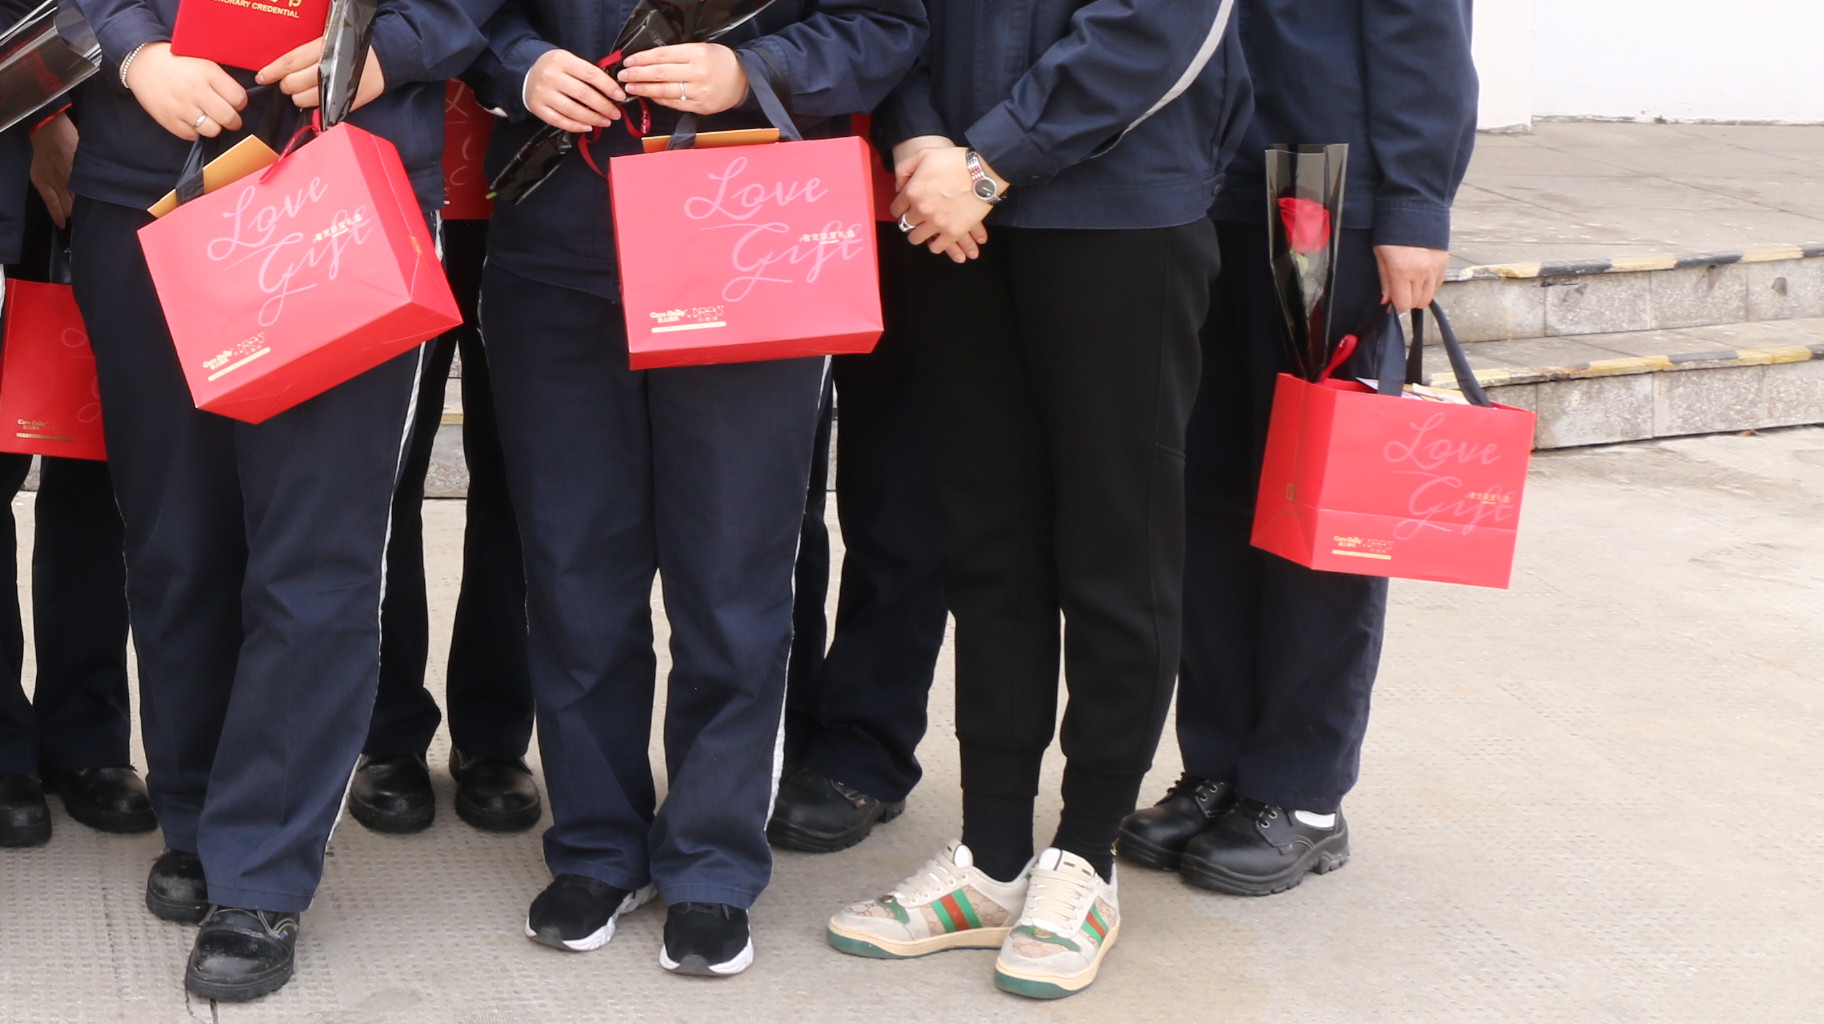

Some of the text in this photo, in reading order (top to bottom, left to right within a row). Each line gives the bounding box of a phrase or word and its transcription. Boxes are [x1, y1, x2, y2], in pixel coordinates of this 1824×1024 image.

[251, 2, 300, 19] CREDENTIAL
[207, 177, 329, 261] Love
[683, 157, 829, 220] Love
[225, 205, 373, 326] Gift
[699, 220, 863, 302] Gift
[1383, 413, 1501, 470] Love
[1391, 470, 1515, 540] Gift
